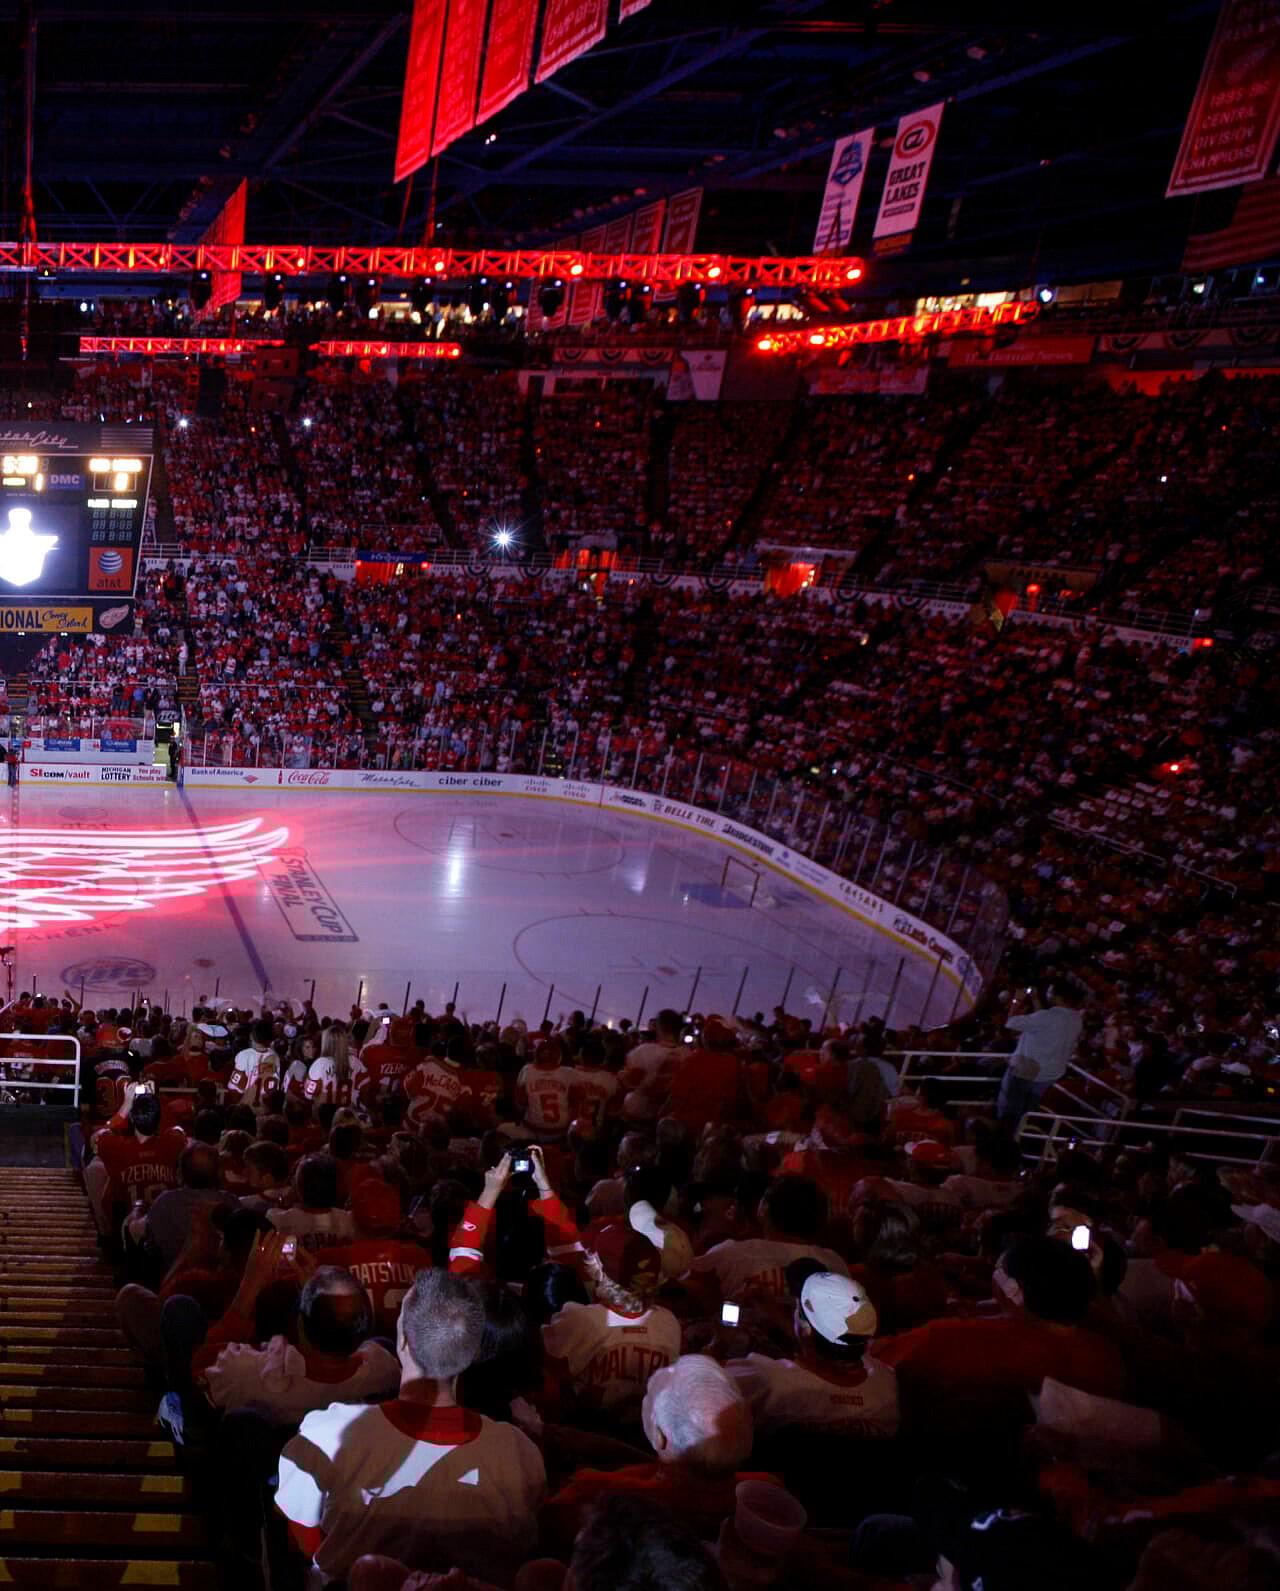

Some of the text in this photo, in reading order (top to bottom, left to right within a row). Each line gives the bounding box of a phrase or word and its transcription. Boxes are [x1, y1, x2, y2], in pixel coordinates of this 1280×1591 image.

[1195, 125, 1256, 149] DIVISION
[1184, 144, 1257, 170] CHAMPIONS
[889, 161, 926, 187] GREAT
[885, 182, 921, 206] LAKES
[51, 474, 80, 485] DMC
[101, 772, 131, 781] LOTTERY
[191, 768, 208, 776] Bank
[438, 776, 504, 787] ciber ciber
[664, 805, 716, 829] BELLE TIRE
[839, 881, 885, 914] CAESARS
[310, 905, 343, 934] CUP
[348, 1261, 416, 1286] DATSYUK
